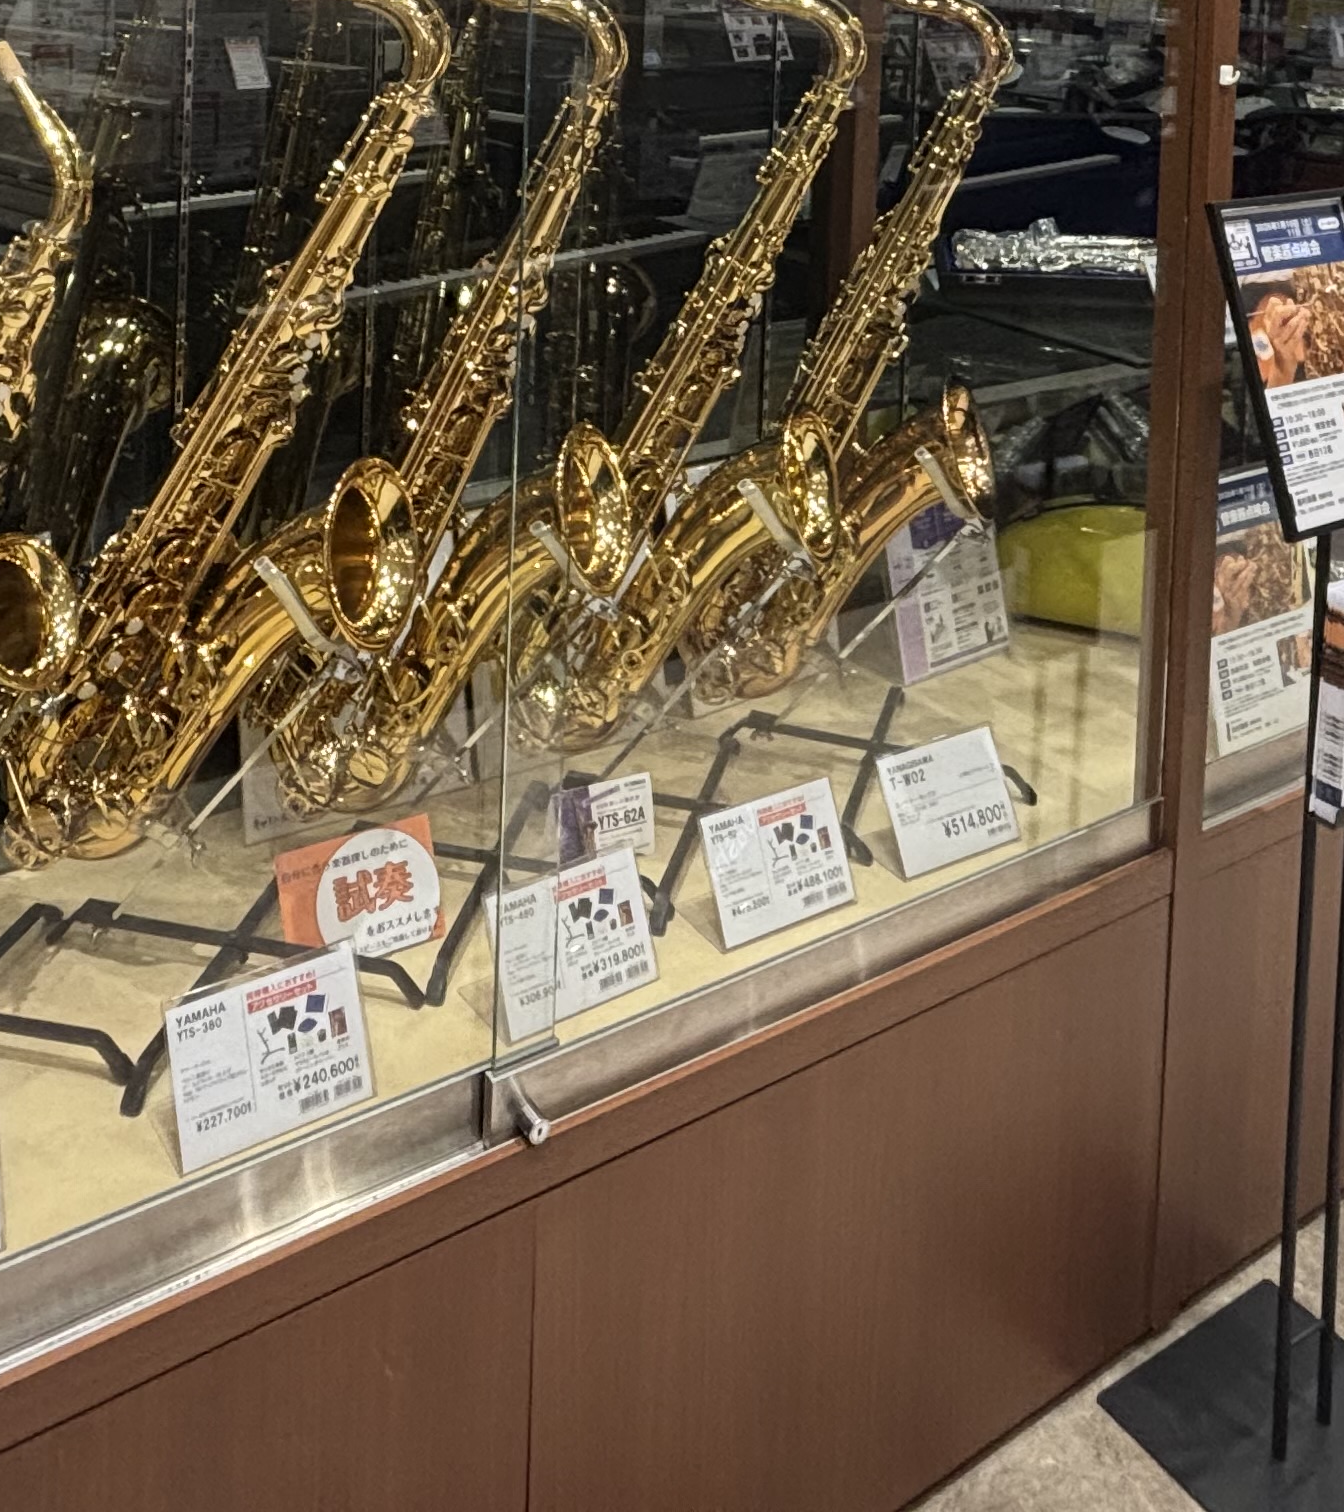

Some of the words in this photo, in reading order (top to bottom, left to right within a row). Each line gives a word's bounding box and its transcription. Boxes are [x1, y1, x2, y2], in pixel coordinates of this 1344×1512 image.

[888, 769, 926, 790] T-W02
[598, 806, 645, 830] YTS-62A
[333, 860, 414, 922] 試奏
[175, 1001, 226, 1029] YAMAHA
[176, 1018, 223, 1043] YTS-380
